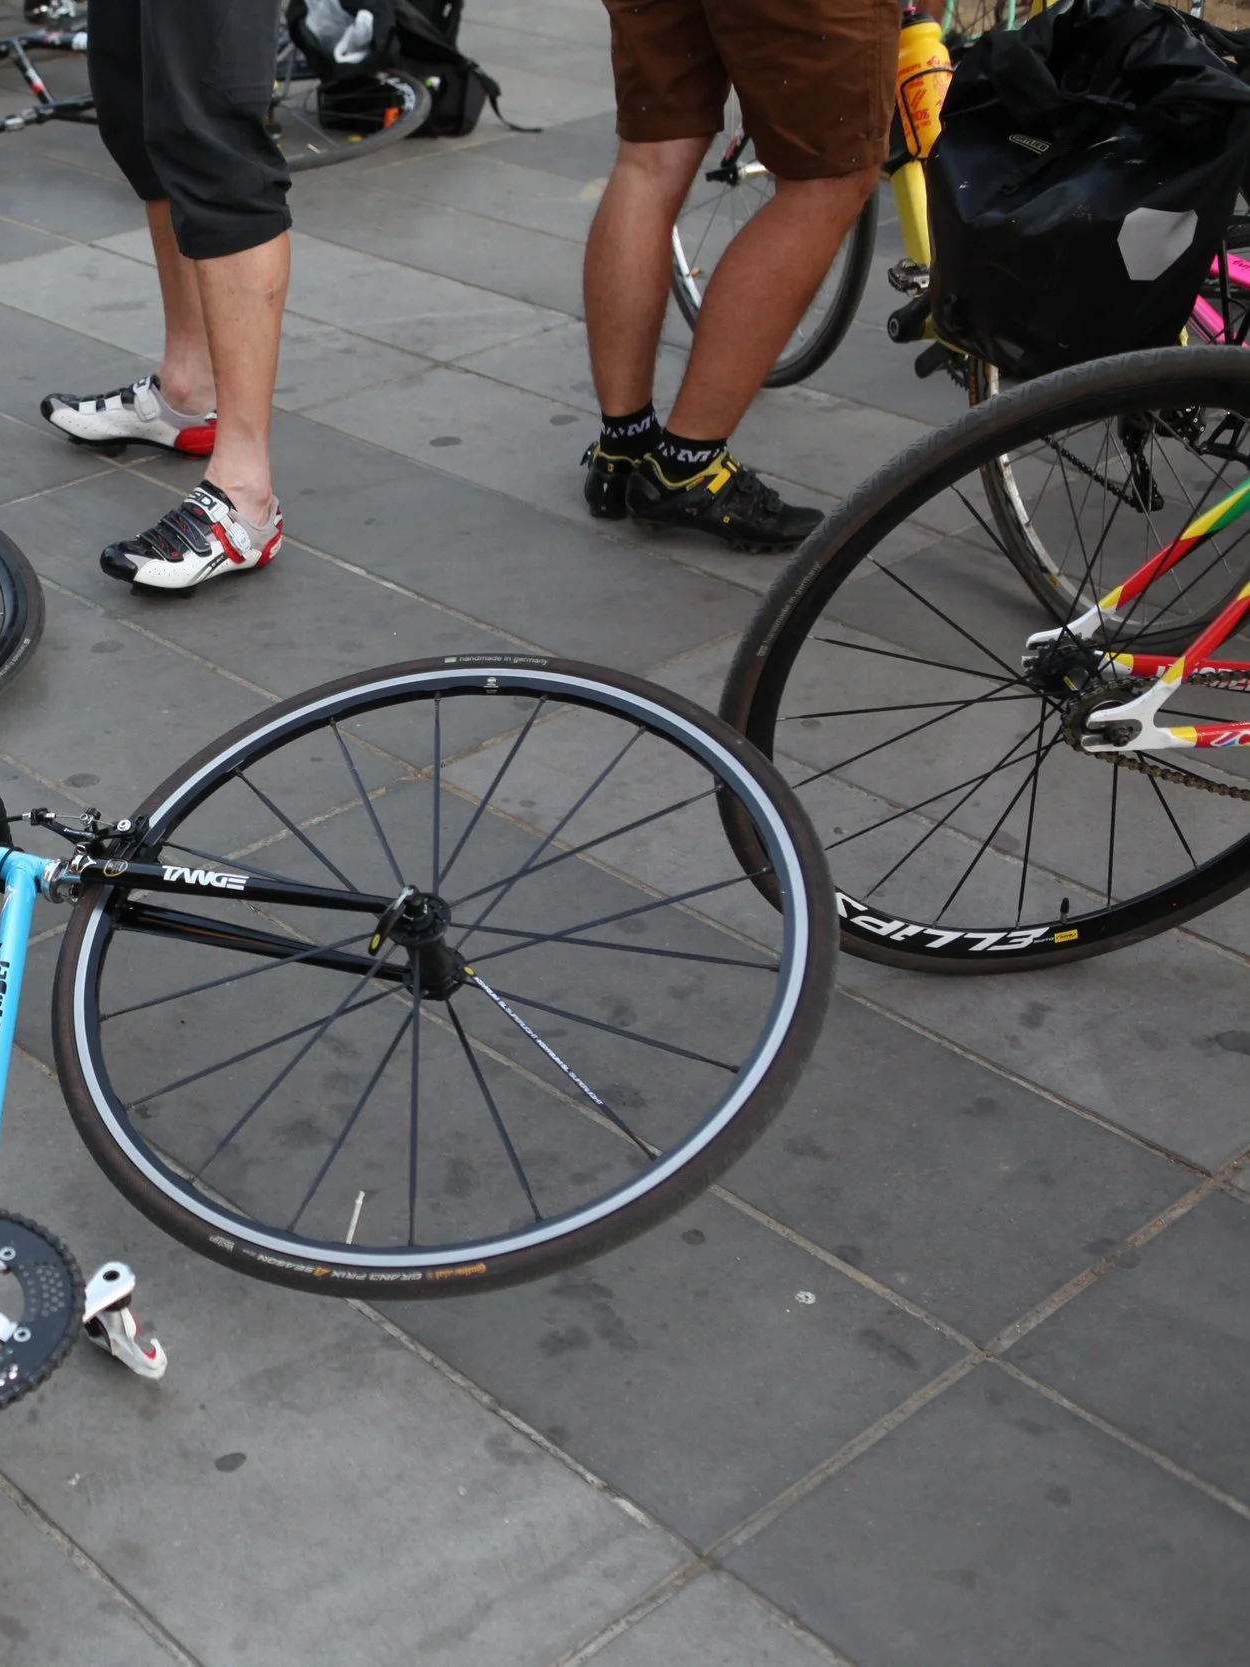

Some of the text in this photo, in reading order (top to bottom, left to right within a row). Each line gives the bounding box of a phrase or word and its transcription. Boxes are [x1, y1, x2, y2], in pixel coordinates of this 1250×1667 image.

[162, 864, 250, 891] TANGE
[834, 892, 1050, 950] ELLIPS
[257, 1253, 314, 1275] SEASON
[330, 1269, 368, 1279] PRIX
[368, 1271, 423, 1281] GRAND
